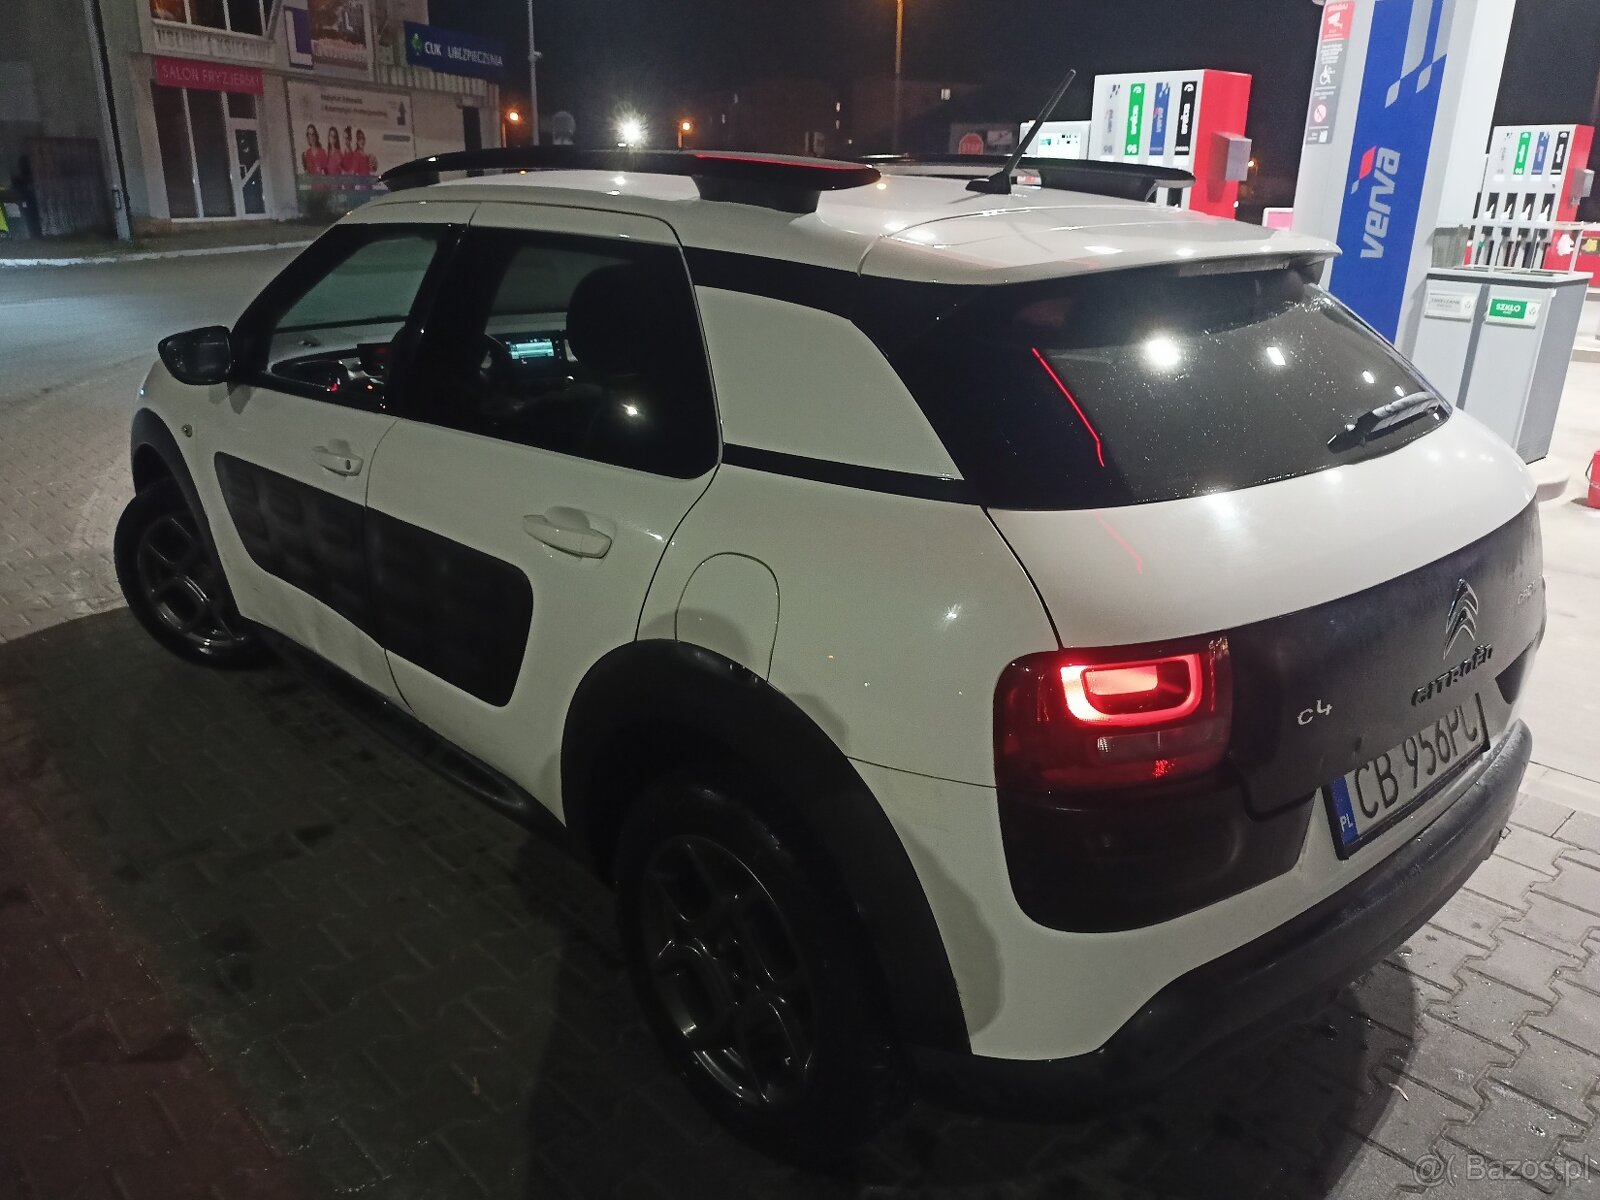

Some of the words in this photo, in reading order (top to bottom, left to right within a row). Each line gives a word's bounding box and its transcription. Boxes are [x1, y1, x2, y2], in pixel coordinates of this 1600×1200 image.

[424, 41, 442, 56] CUK
[161, 64, 199, 82] SALON
[202, 68, 260, 86] FRYZJERSKI
[1360, 147, 1401, 259] verva
[1495, 303, 1521, 313] SZKŁO
[1354, 752, 1399, 819] CB
[1340, 813, 1354, 832] PL
